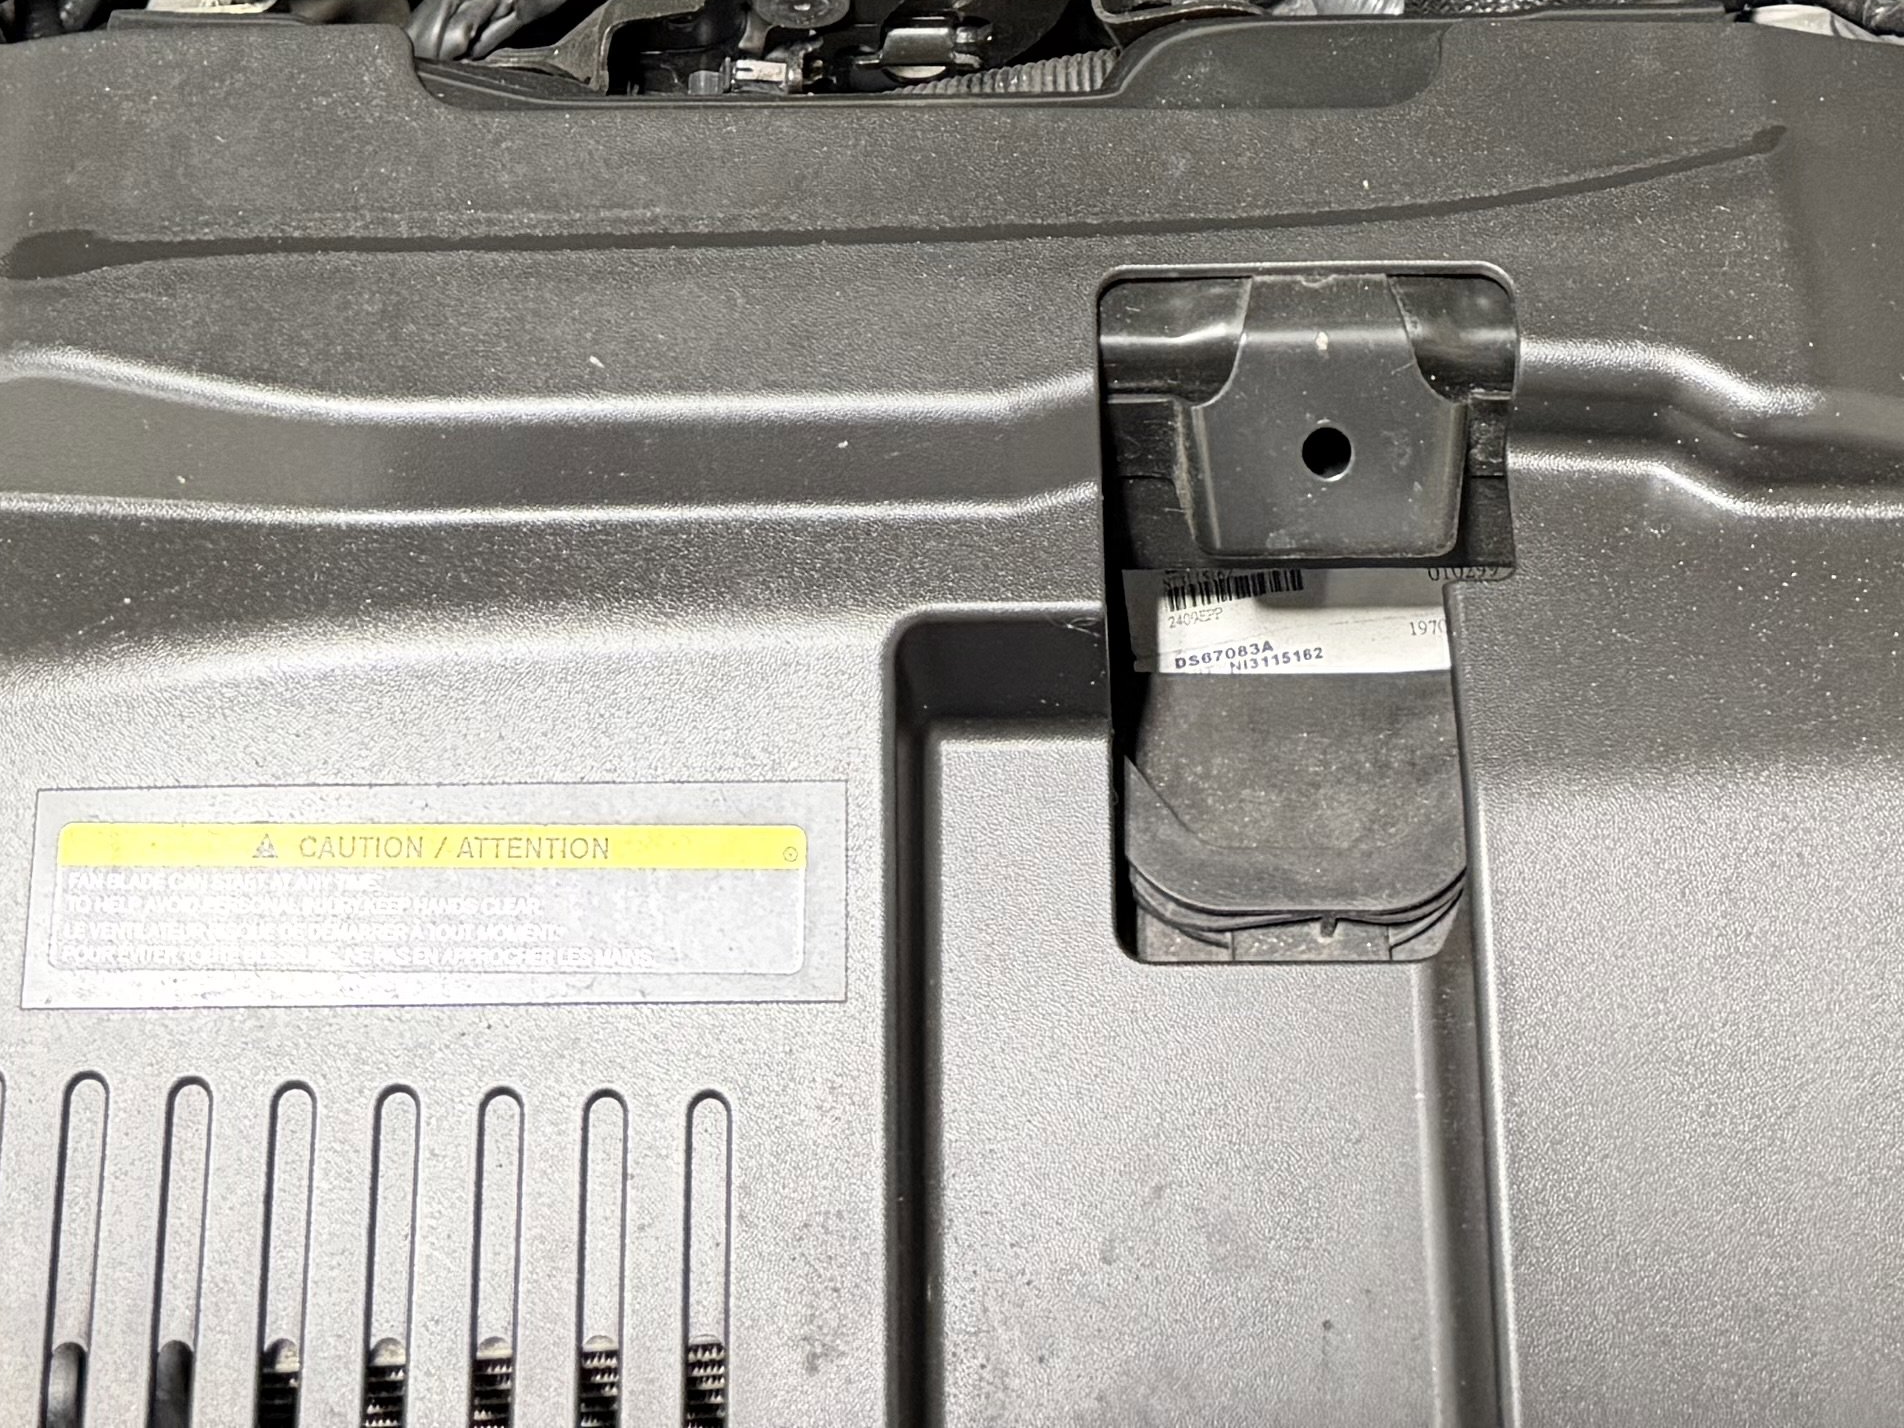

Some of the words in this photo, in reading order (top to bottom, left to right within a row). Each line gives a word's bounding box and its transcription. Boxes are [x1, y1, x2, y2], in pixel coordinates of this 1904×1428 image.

[1175, 640, 1274, 670] DS67083A
[298, 835, 424, 860] CAUTION
[433, 835, 449, 860] /
[456, 835, 610, 861] ATTENTION
